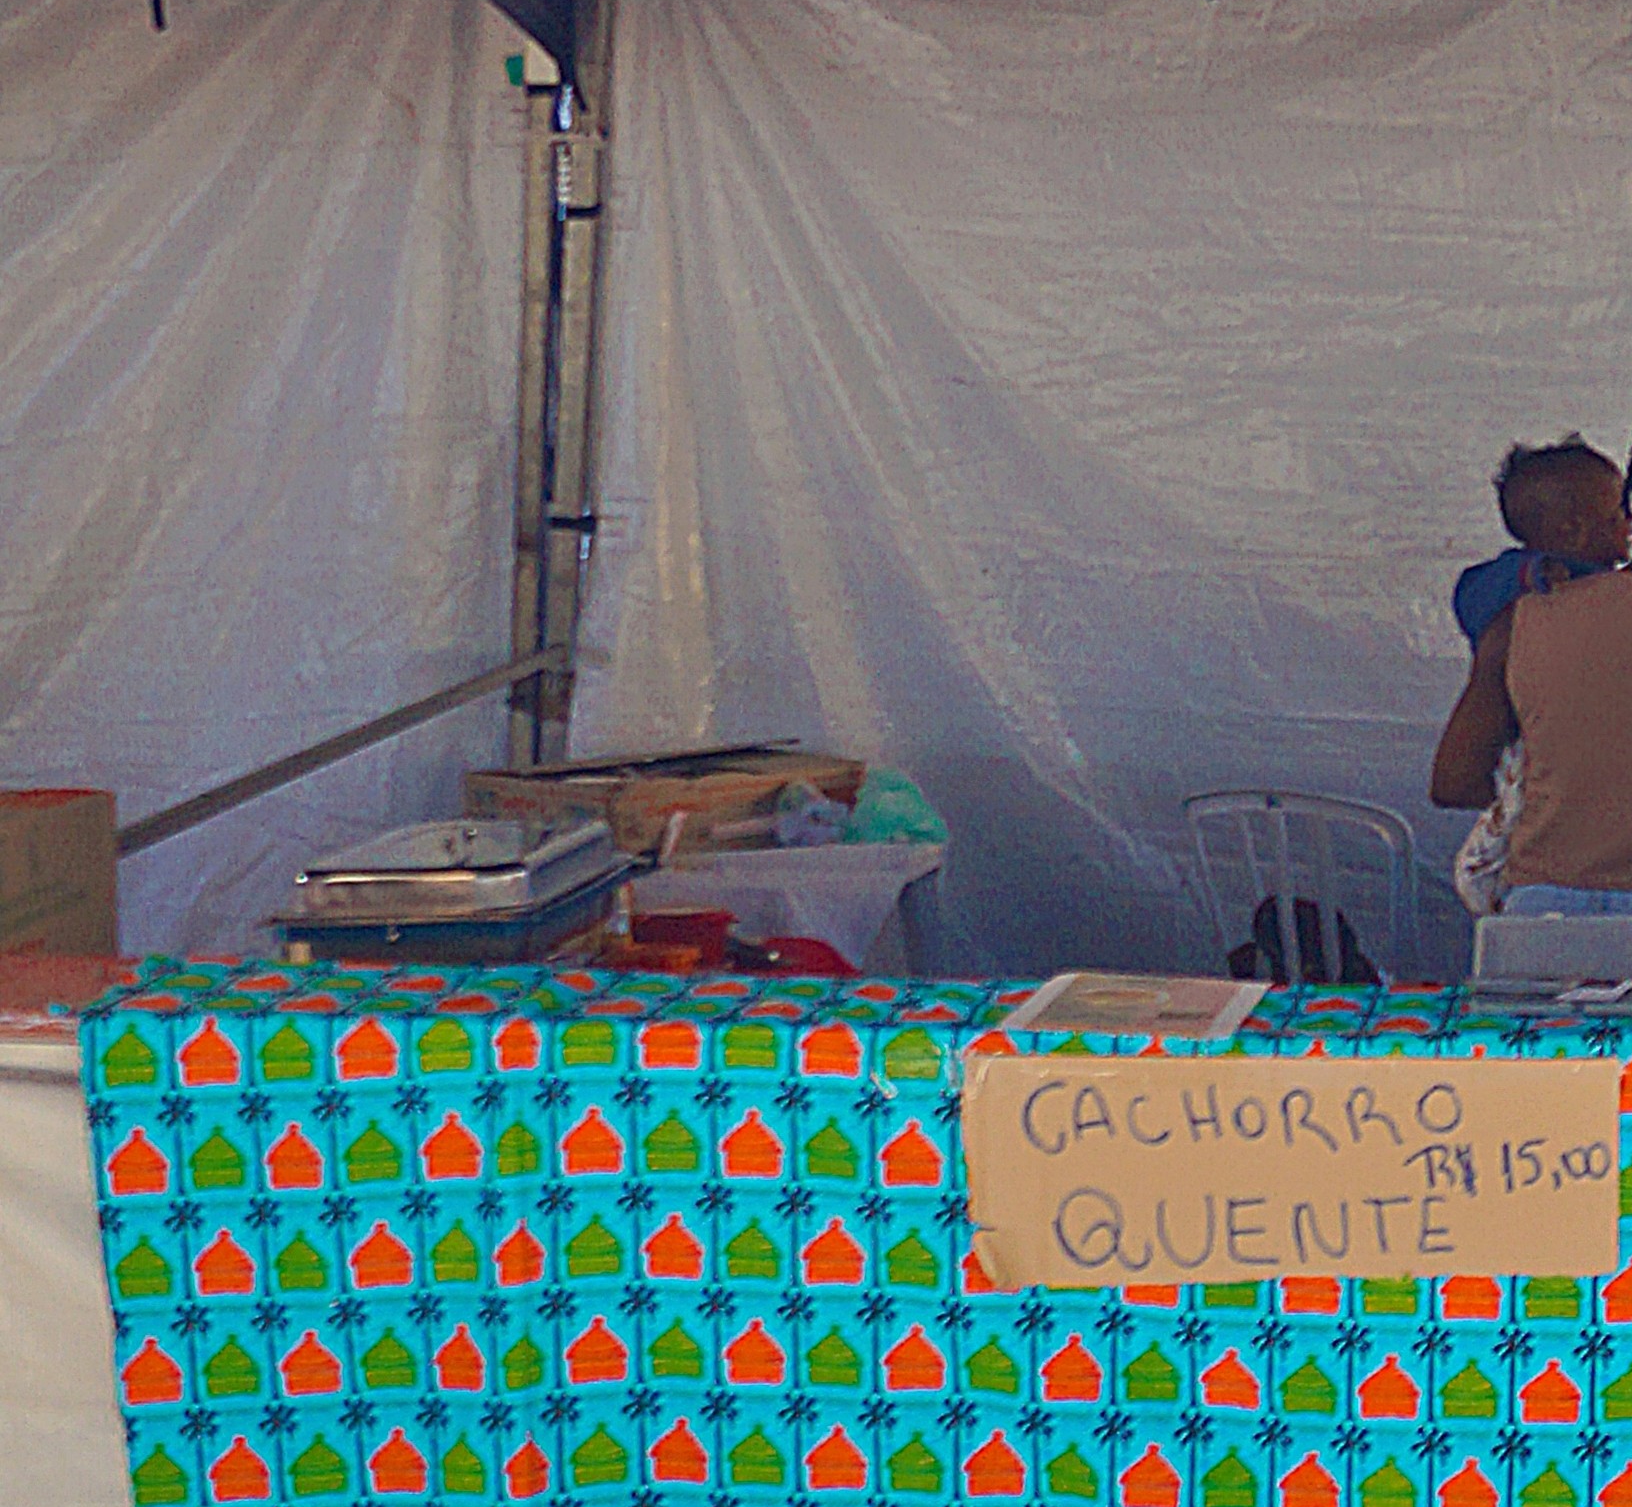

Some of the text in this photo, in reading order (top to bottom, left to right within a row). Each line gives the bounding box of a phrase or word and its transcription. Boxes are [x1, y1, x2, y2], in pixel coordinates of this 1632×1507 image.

[1021, 1080, 1463, 1155] CACHORRO
[1502, 1138, 1612, 1193] 15,00
[1052, 1187, 1456, 1271] QUENTE
